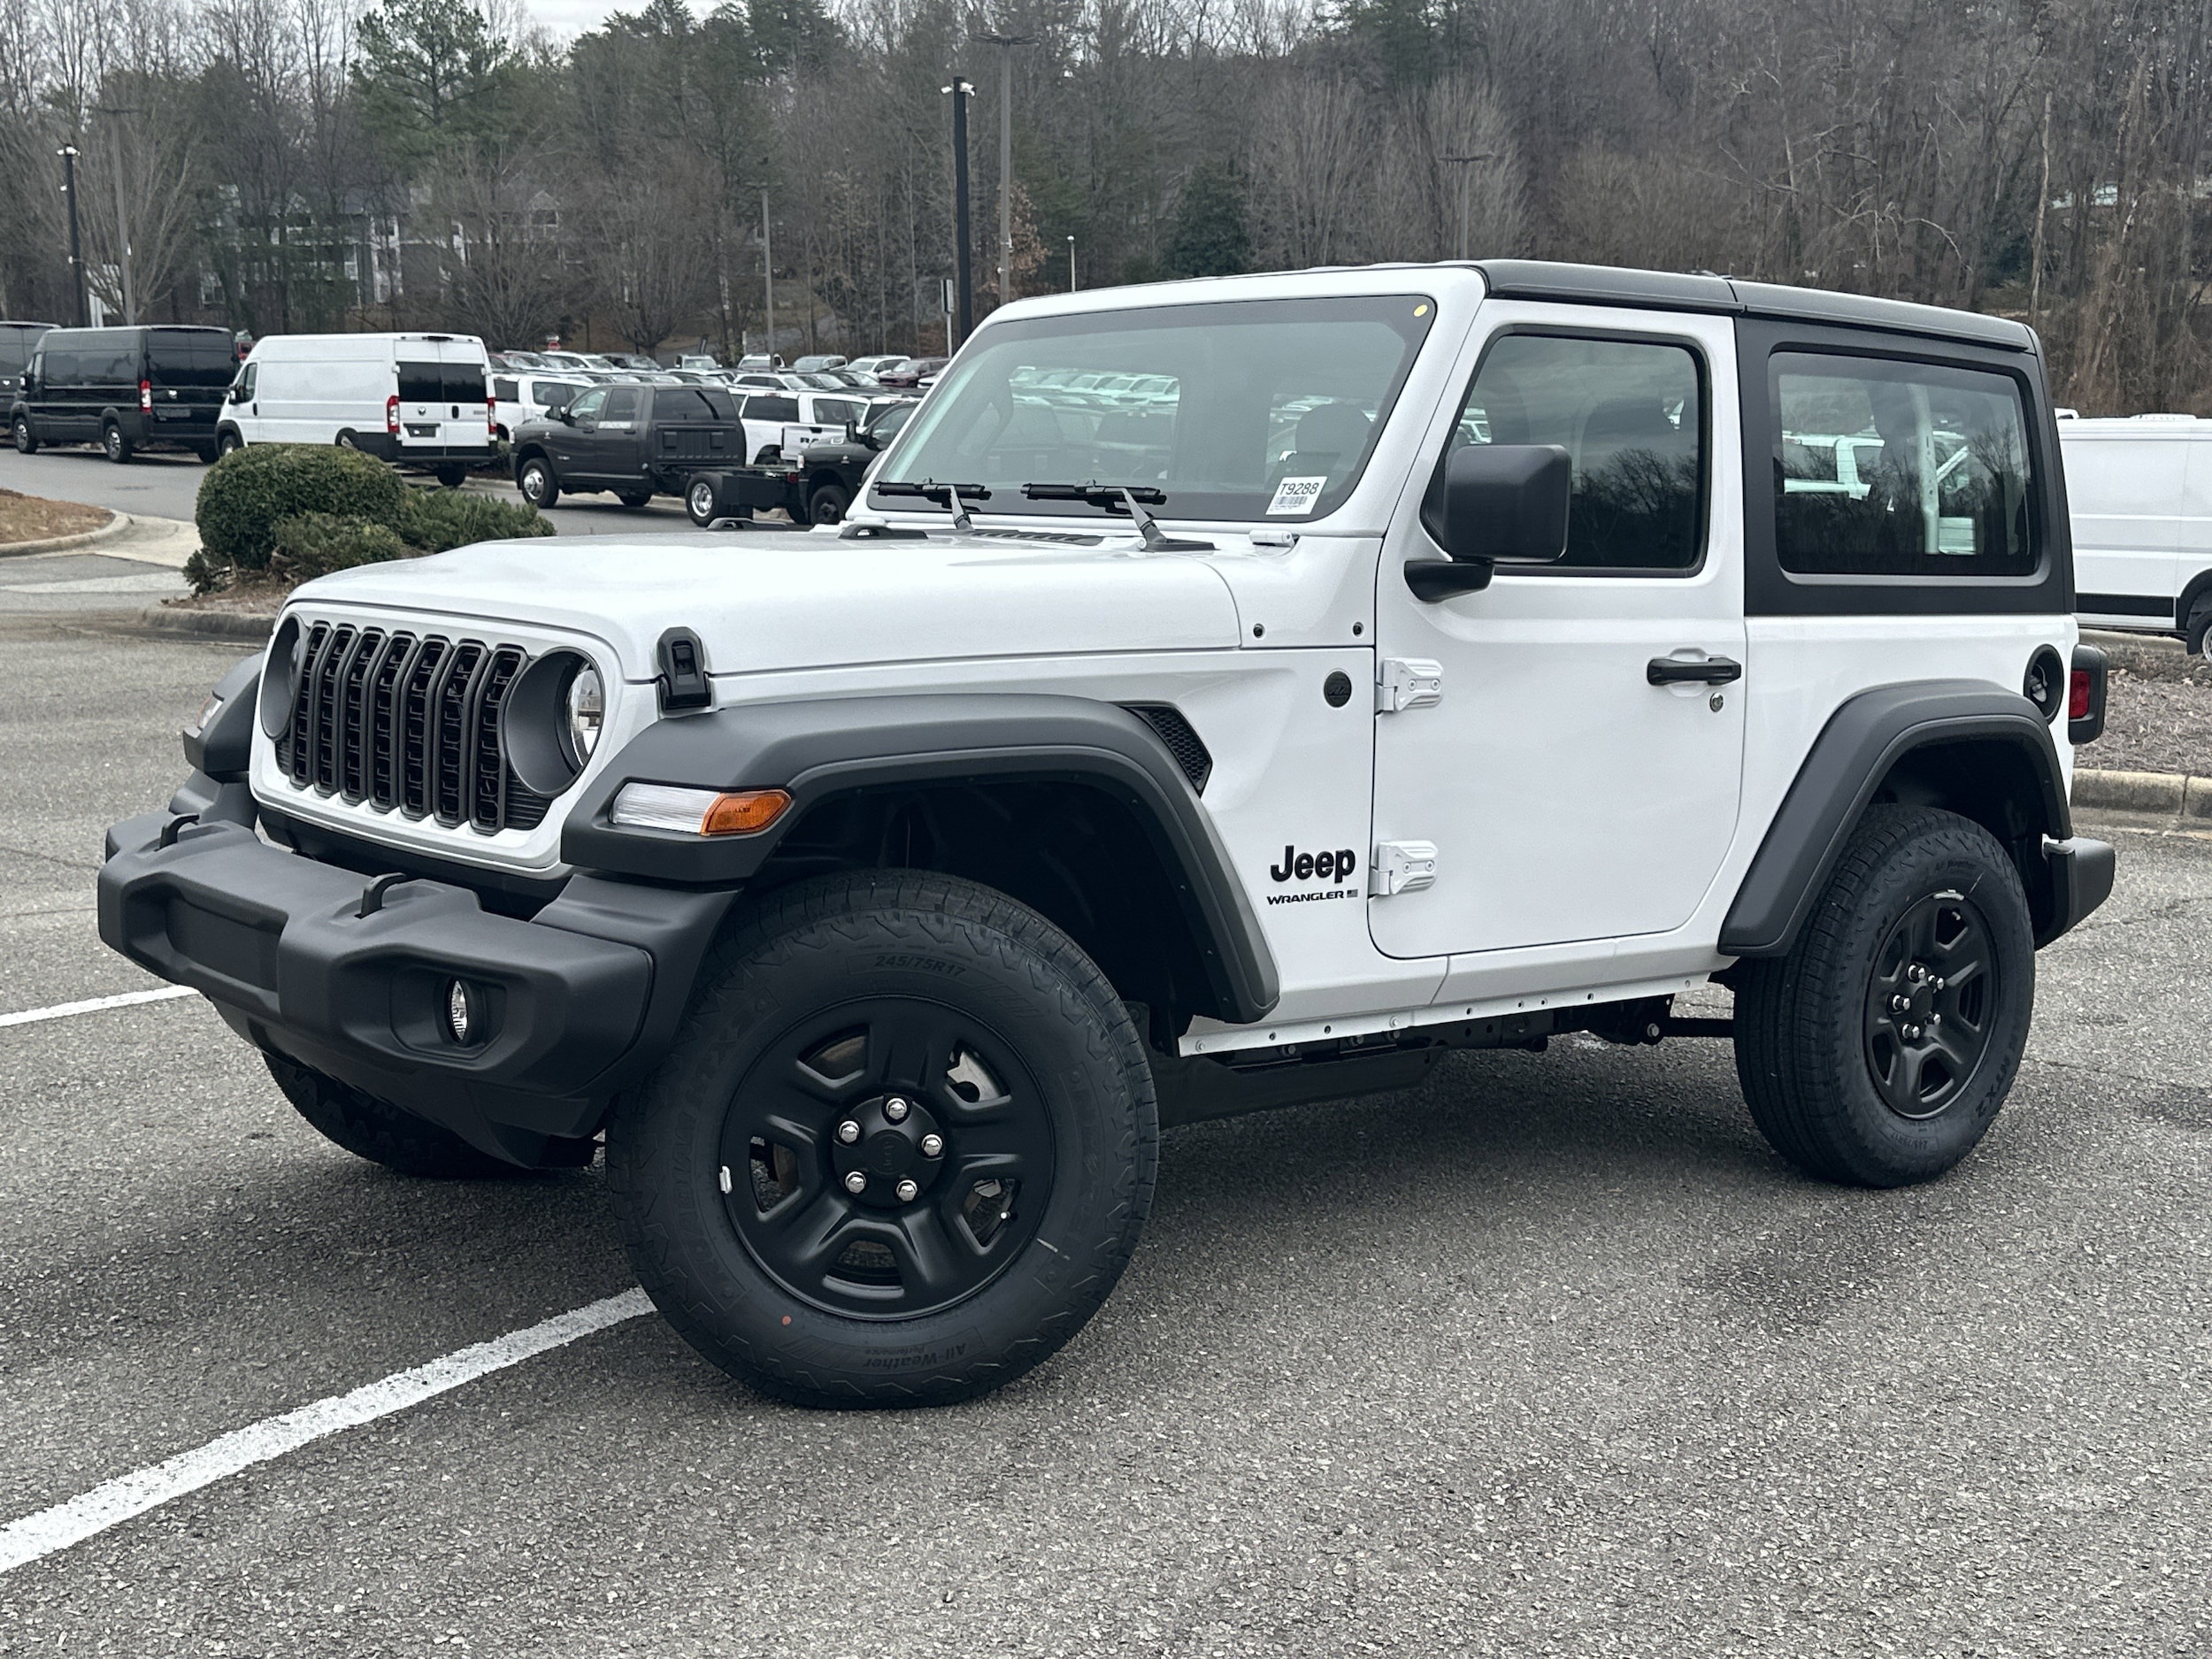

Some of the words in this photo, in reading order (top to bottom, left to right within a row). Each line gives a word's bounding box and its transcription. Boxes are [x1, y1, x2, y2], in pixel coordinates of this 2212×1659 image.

[1279, 482, 1320, 495] T9288
[1270, 844, 1356, 884] Jeep
[1266, 890, 1344, 904] WRANGLER
[872, 956, 967, 977] 245/75R17
[863, 1343, 967, 1370] All-Weather
